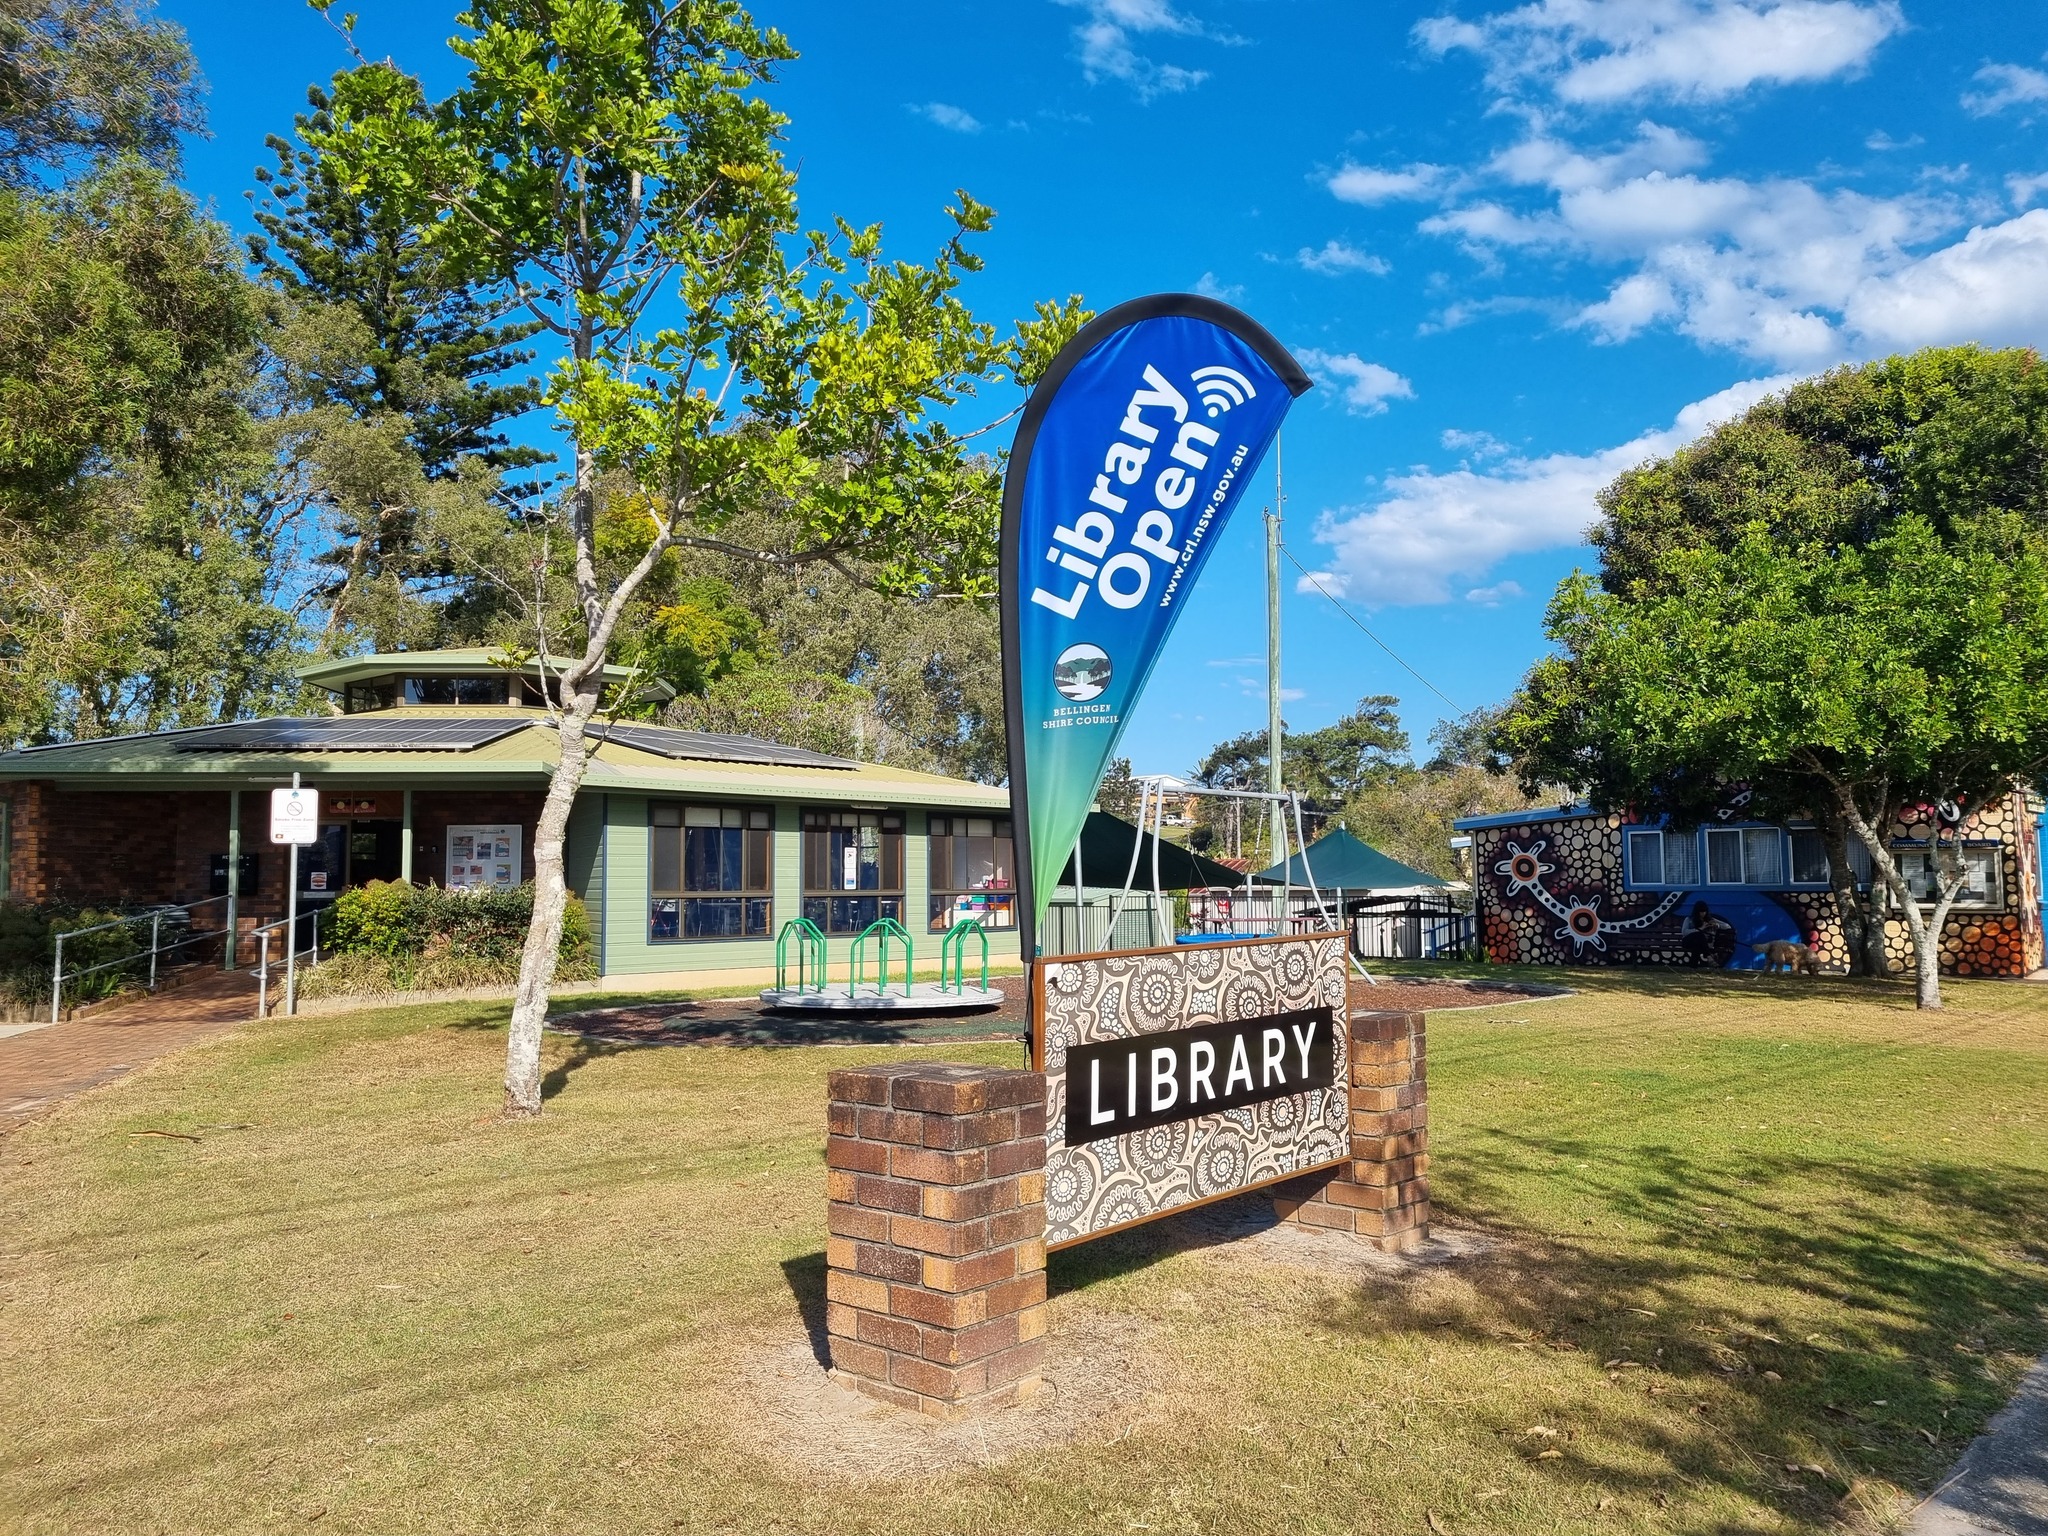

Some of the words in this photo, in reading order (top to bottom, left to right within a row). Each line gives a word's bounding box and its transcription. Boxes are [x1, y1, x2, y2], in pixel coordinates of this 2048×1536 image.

[1030, 363, 1189, 620] Library
[1098, 421, 1220, 610] Open
[1159, 444, 1249, 608] www.crl.nsw.gov.au
[1042, 718, 1074, 729] SHIRE
[1076, 715, 1119, 725] COUNCIL
[1053, 704, 1111, 717] BELLINGEN
[1090, 1021, 1317, 1126] LIBRARY
